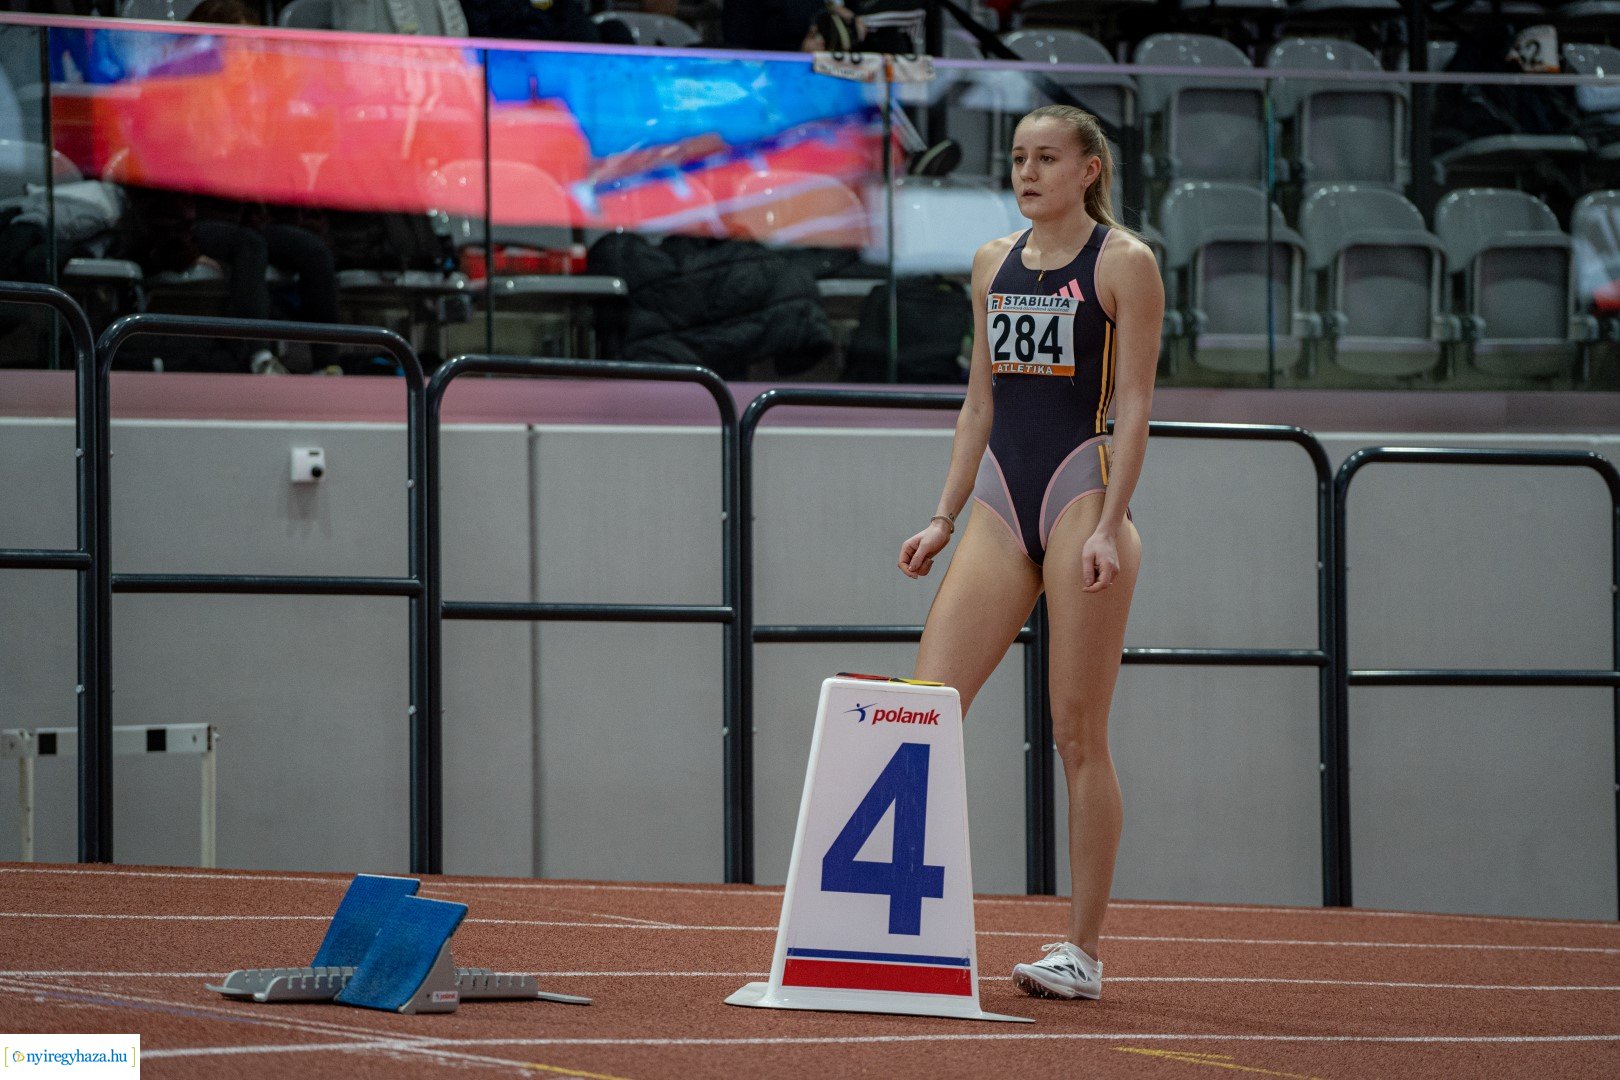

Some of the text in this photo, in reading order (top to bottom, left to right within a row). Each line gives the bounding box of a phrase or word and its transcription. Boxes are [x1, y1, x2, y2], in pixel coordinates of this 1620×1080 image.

[1004, 296, 1070, 308] STABILITA
[992, 313, 1063, 364] 284
[997, 363, 1053, 375] ATLETIKA
[871, 706, 941, 725] polanik
[820, 742, 945, 936] 4
